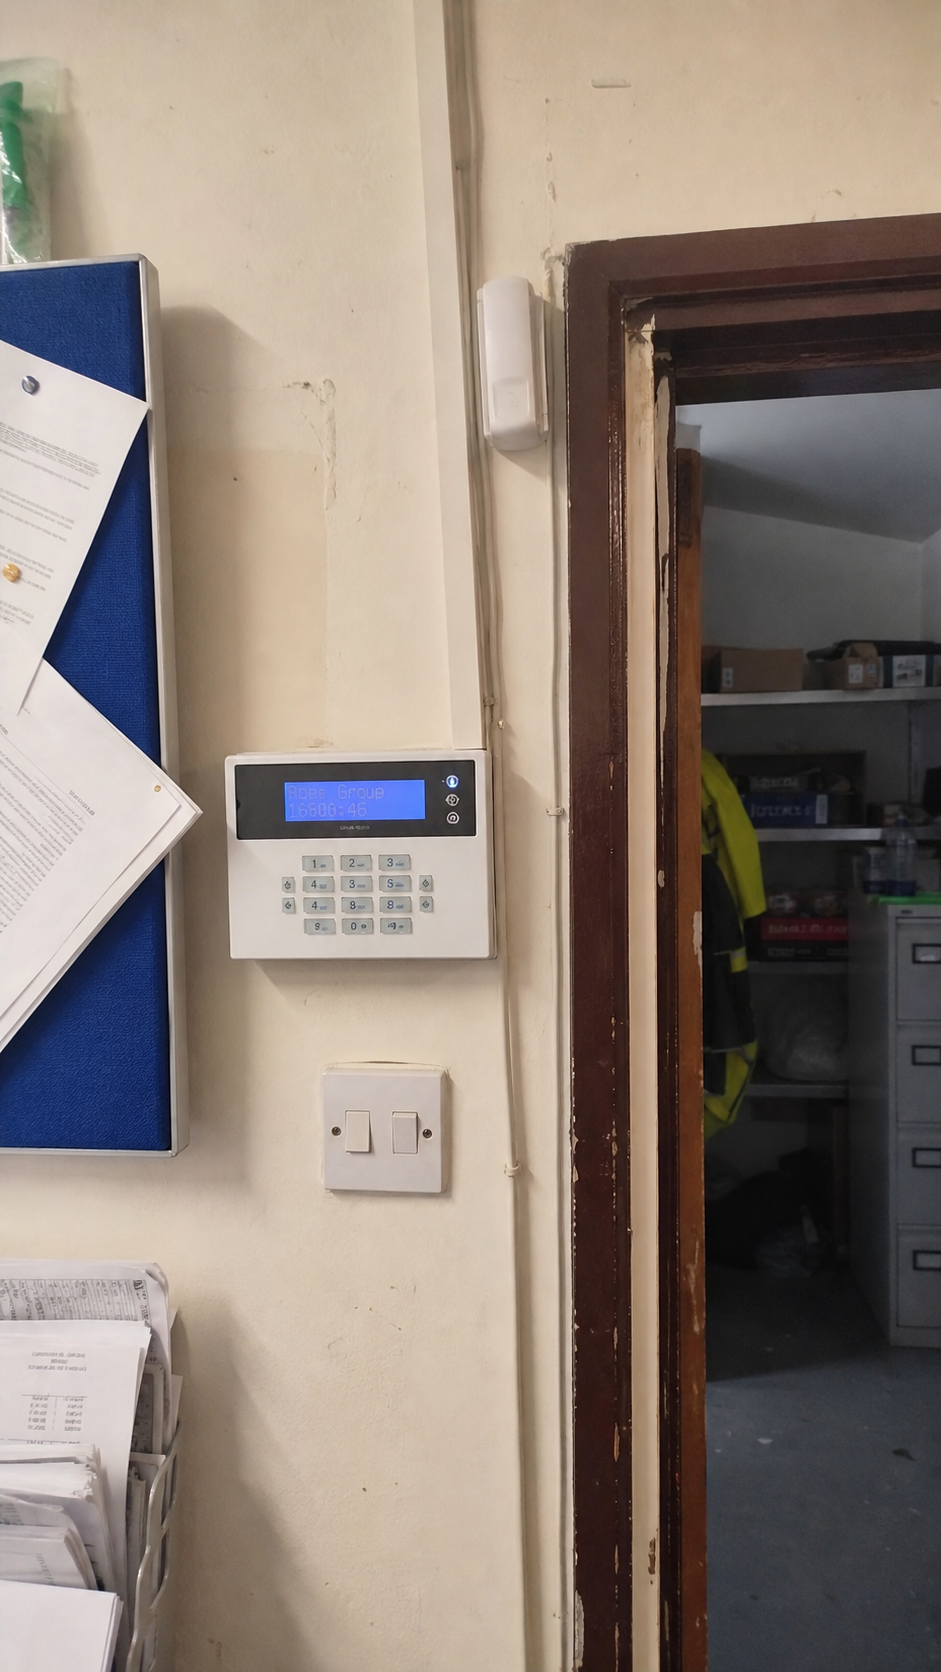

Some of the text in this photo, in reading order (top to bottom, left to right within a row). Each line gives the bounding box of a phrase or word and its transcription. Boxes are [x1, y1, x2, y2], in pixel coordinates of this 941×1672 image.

[312, 859, 317, 869] 1
[349, 858, 355, 868] 2
[386, 857, 394, 868] 3
[310, 879, 317, 890] 4
[311, 901, 318, 910] 4
